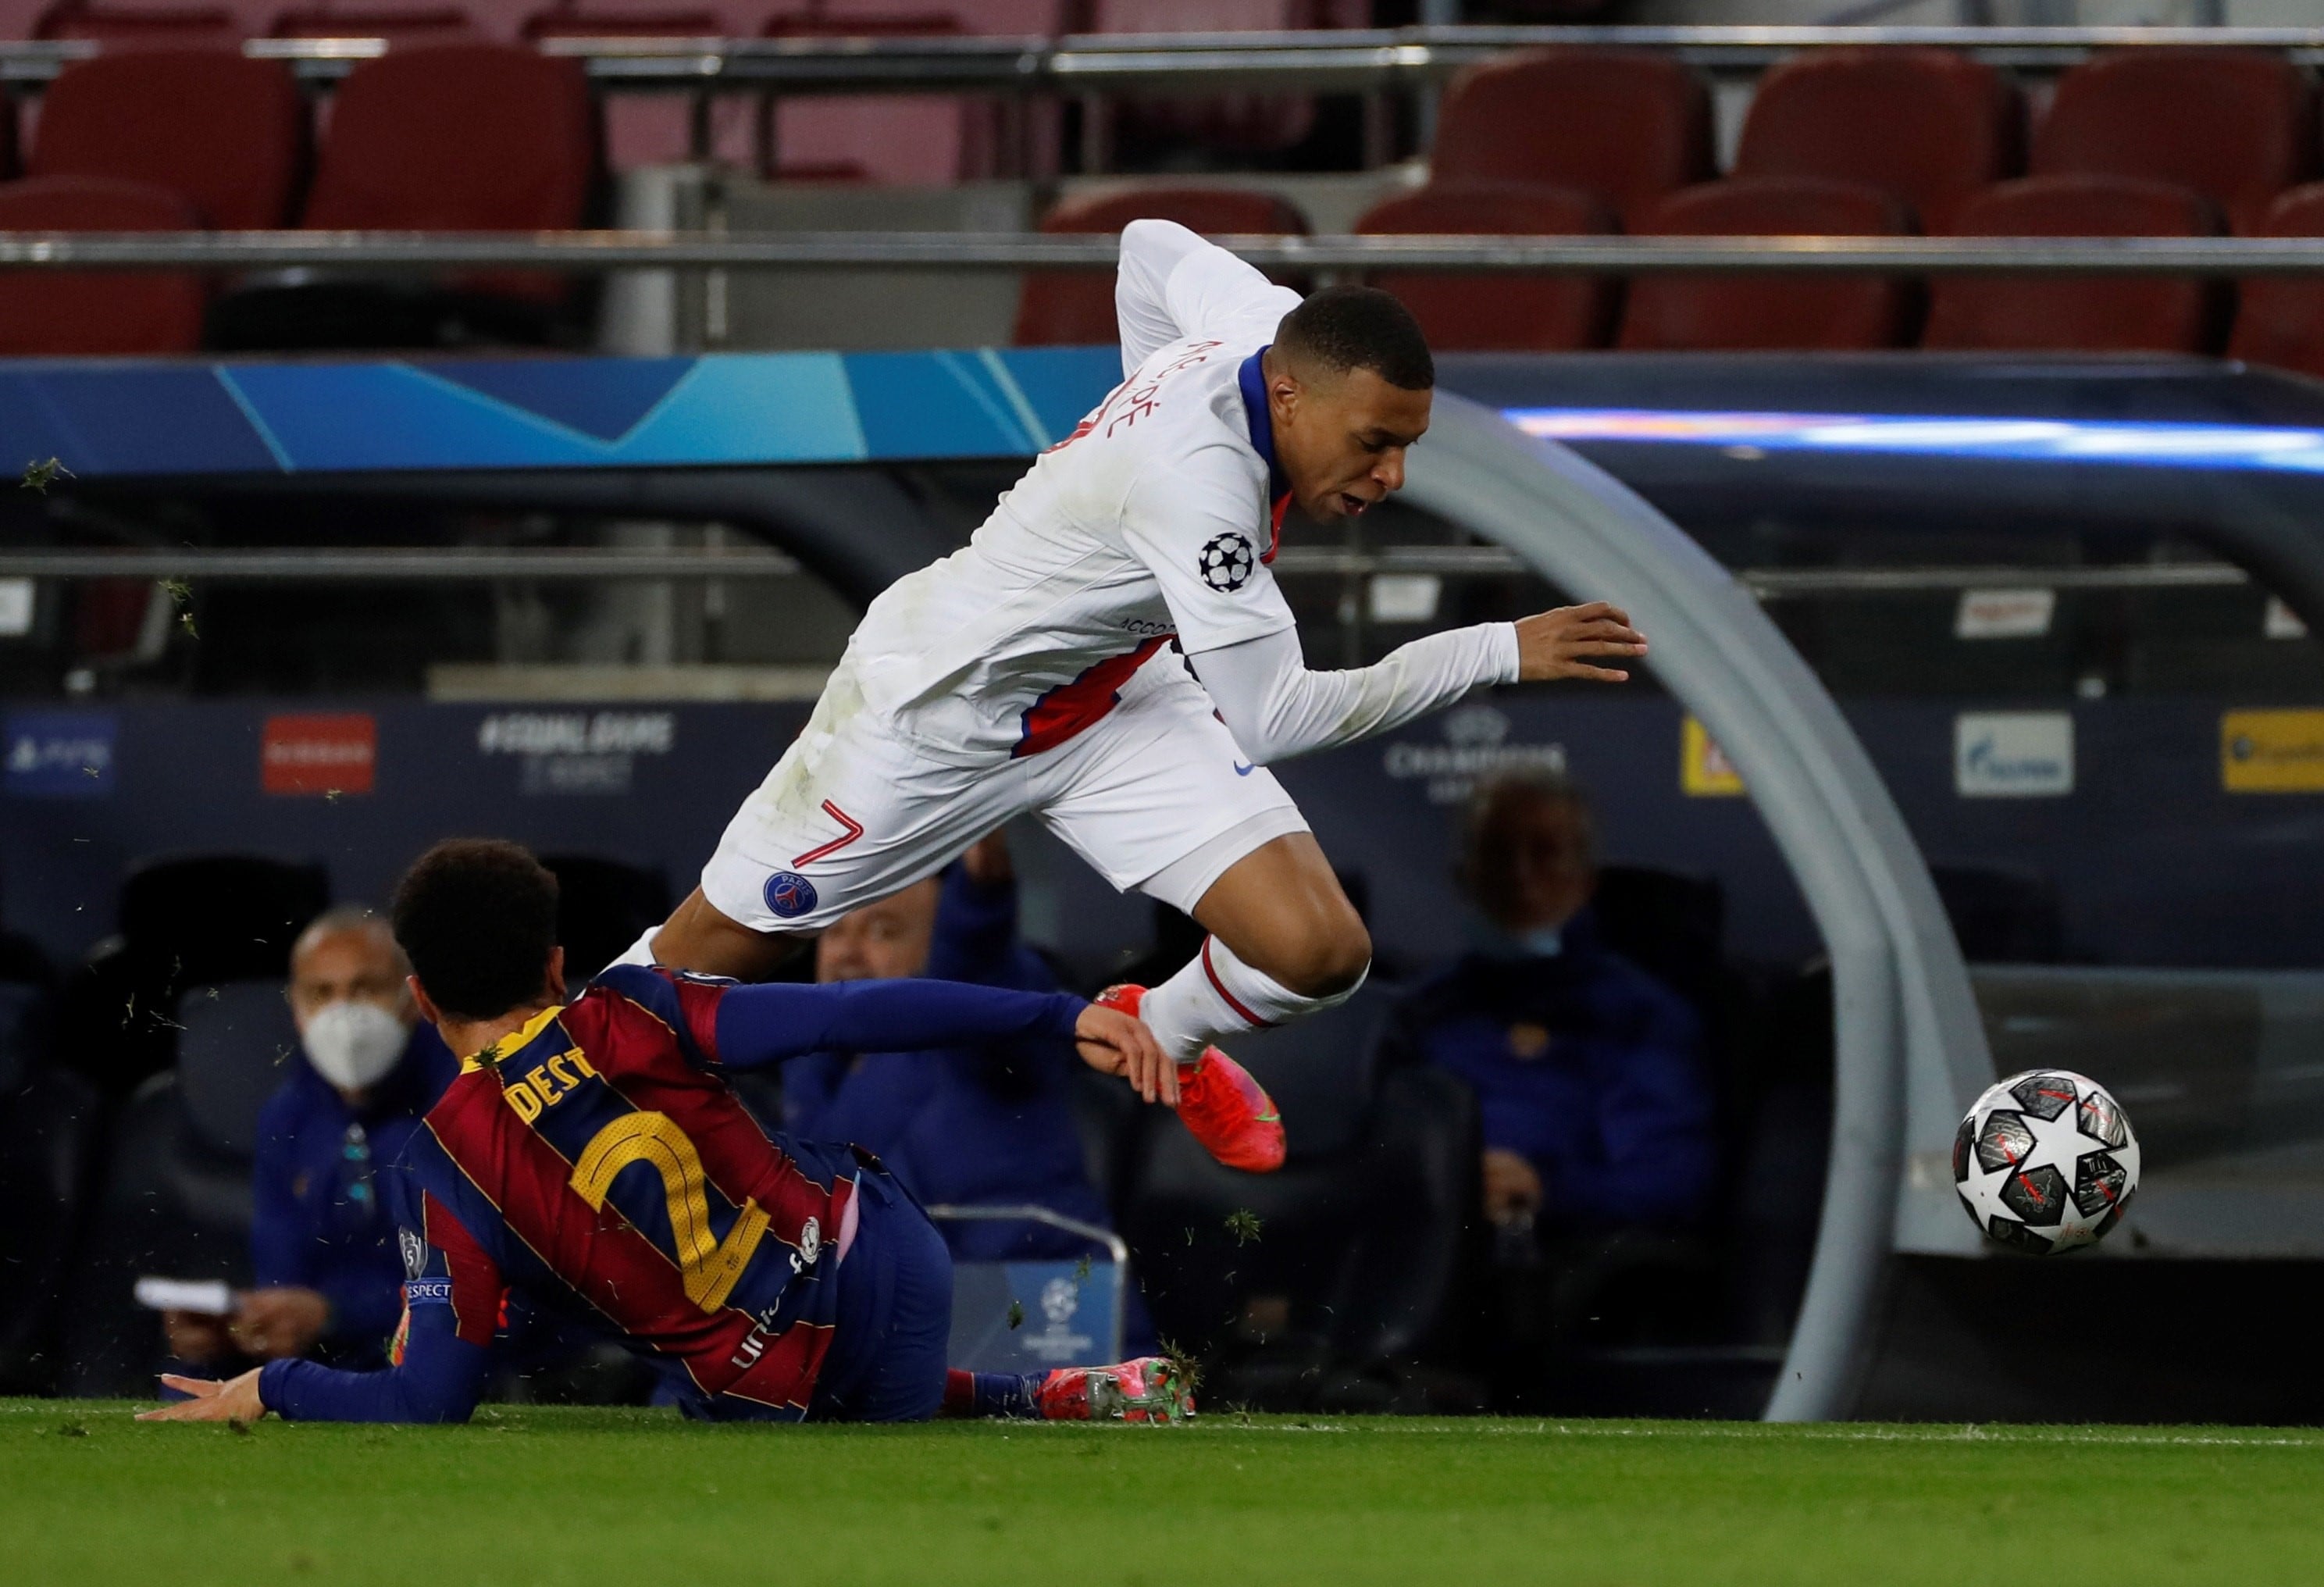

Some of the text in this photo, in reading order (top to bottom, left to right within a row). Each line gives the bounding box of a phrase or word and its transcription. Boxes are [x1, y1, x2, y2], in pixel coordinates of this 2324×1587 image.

[790, 798, 864, 869] 7
[781, 875, 812, 896] PARIS
[502, 1047, 597, 1125] DEST
[569, 1111, 772, 1315] 2
[405, 1250, 415, 1267] 5
[408, 1284, 452, 1299] ESPECT
